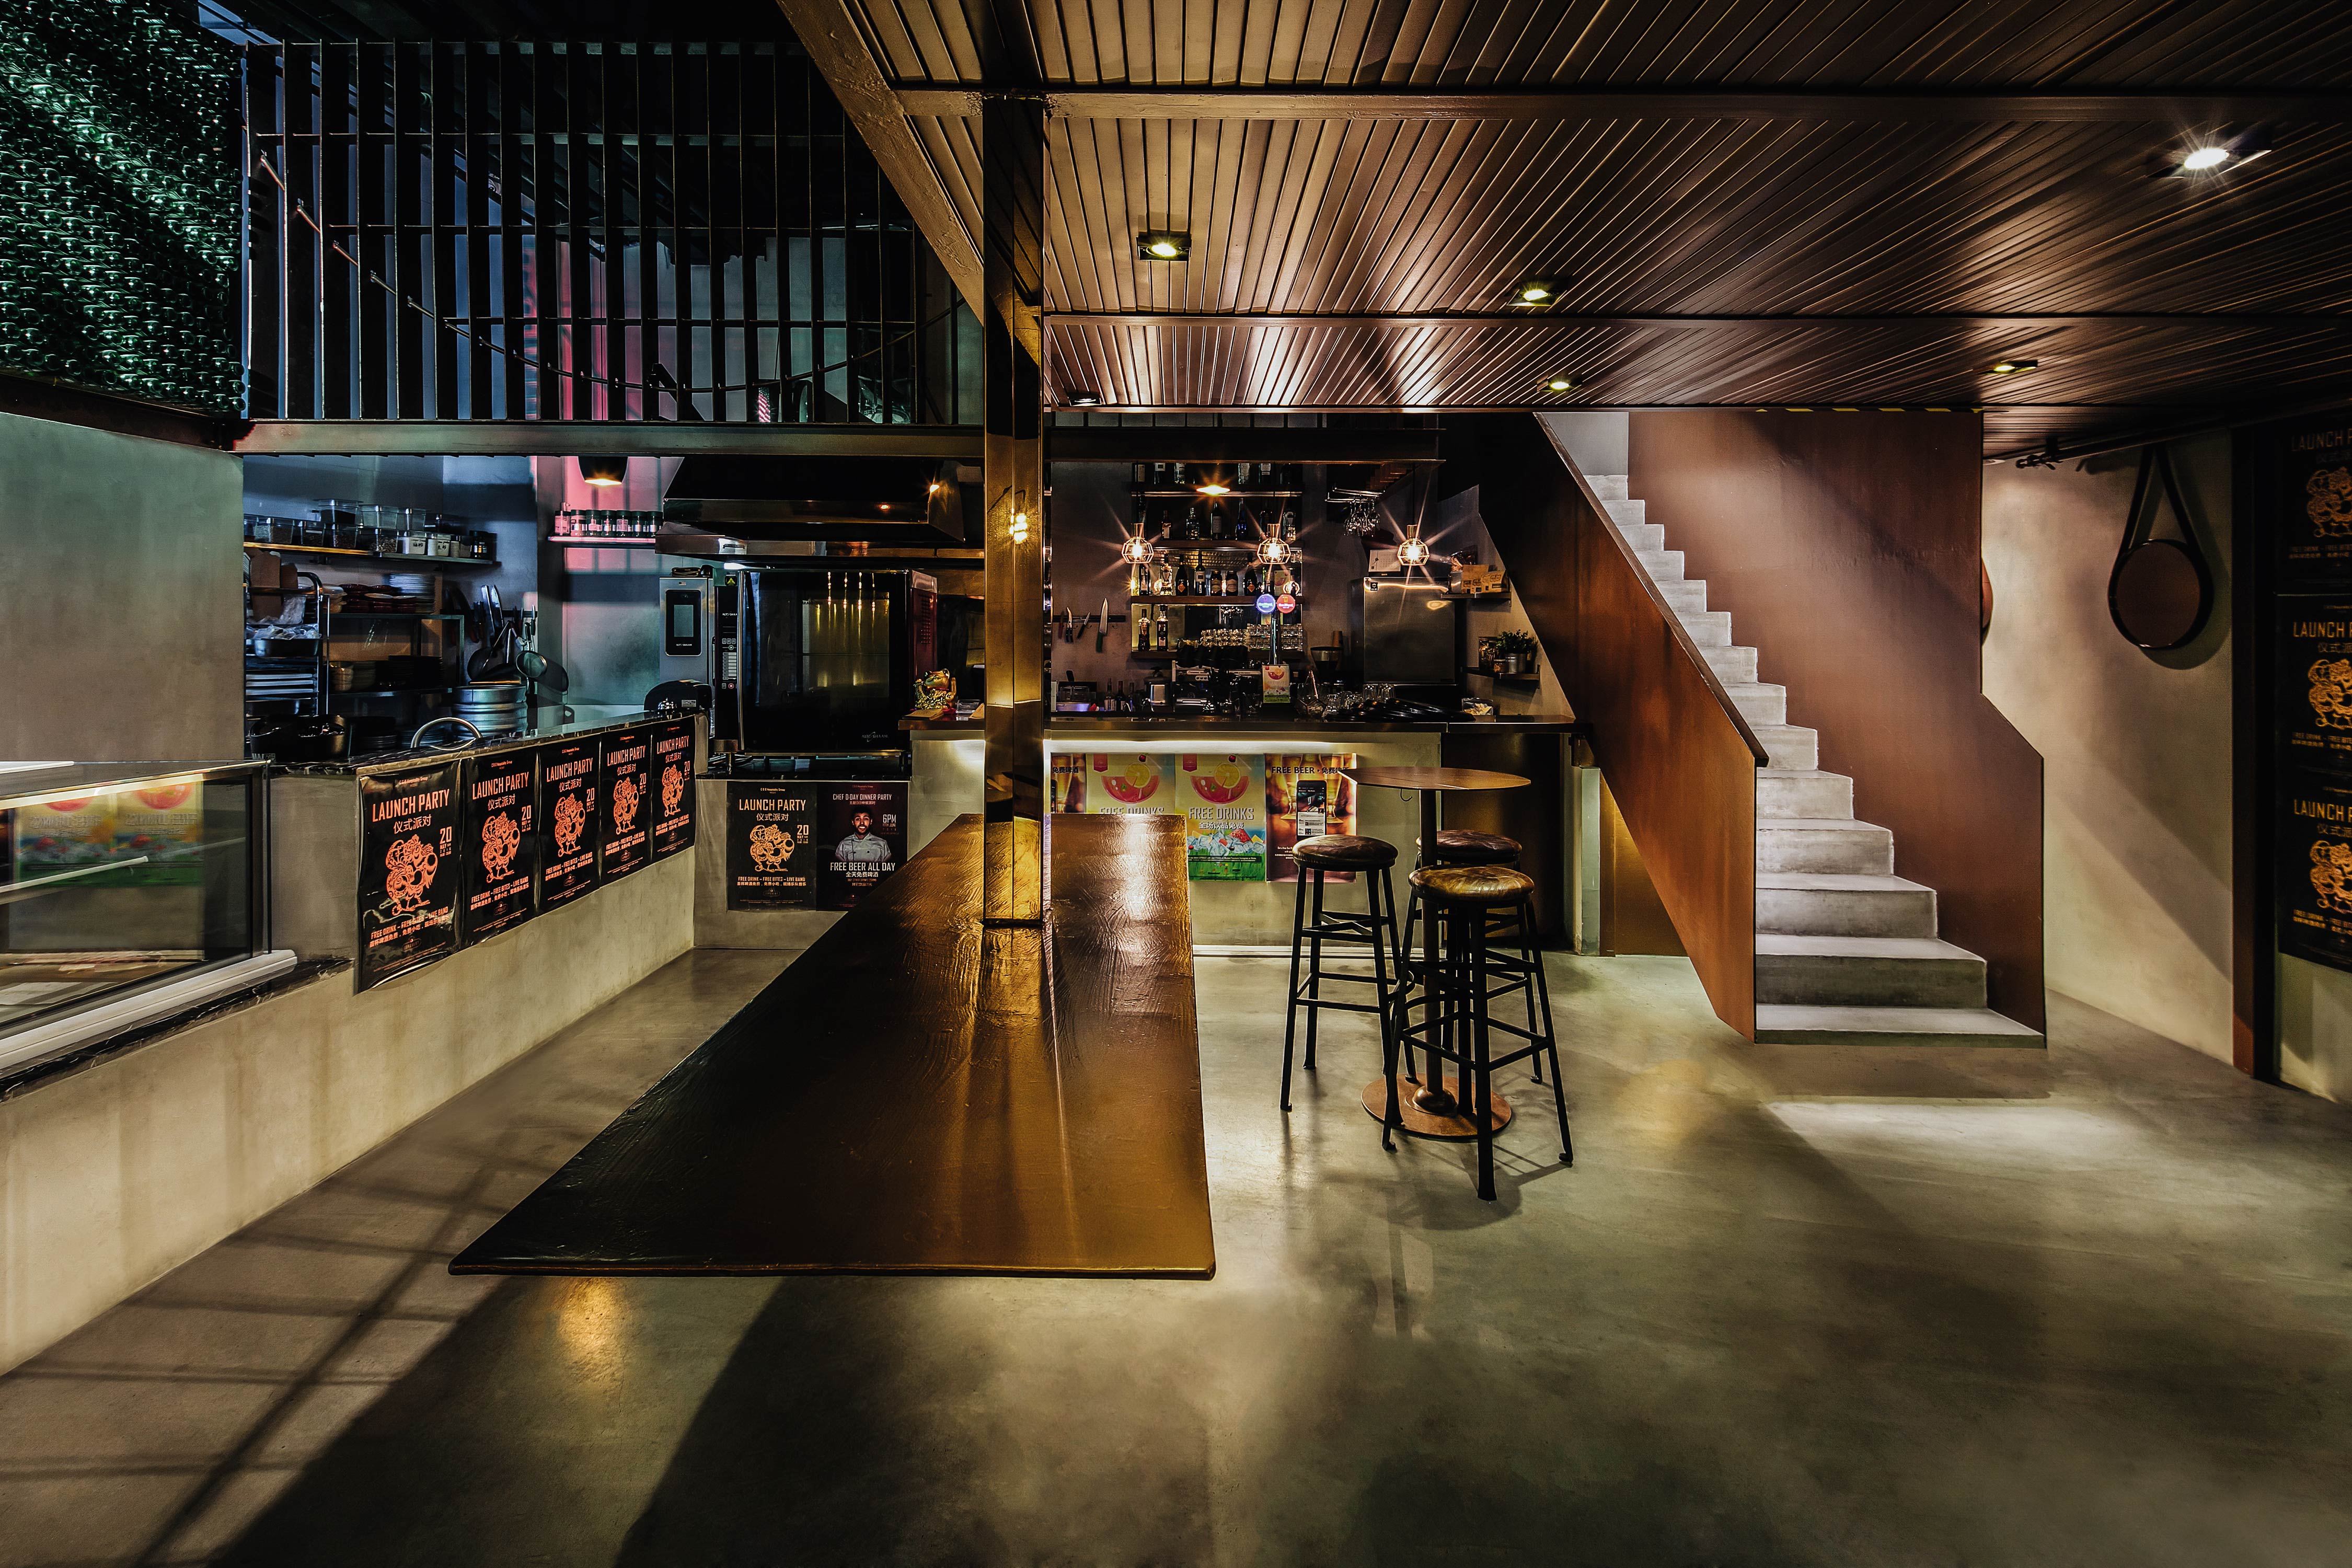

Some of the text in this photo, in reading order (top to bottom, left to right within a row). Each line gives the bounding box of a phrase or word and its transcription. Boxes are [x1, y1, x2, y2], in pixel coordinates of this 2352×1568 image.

[2293, 621, 2345, 638] LAUNCH
[657, 735, 689, 754] LAUNCH PARTY
[607, 745, 645, 766] LAUNCH PARTY
[547, 757, 593, 782] LAUNCH PARTY
[685, 760, 690, 772] 20
[472, 771, 529, 800] LAUNCH PARTY
[640, 773, 646, 785] 20
[488, 793, 515, 811] 仪式派对
[586, 788, 594, 802] 20
[373, 789, 449, 822] LAUNCH PARTY
[522, 805, 531, 821] 20
[739, 799, 806, 811] LAUNCH PARTY
[2294, 799, 2344, 822] LAUNCH
[883, 814, 896, 823] 6PM
[1189, 808, 1254, 820] FREE DRINKS
[394, 814, 432, 834] 仪式派对
[797, 825, 809, 835] 20
[440, 826, 452, 844] 20
[830, 862, 895, 871] FREE BEER ALL DAY
